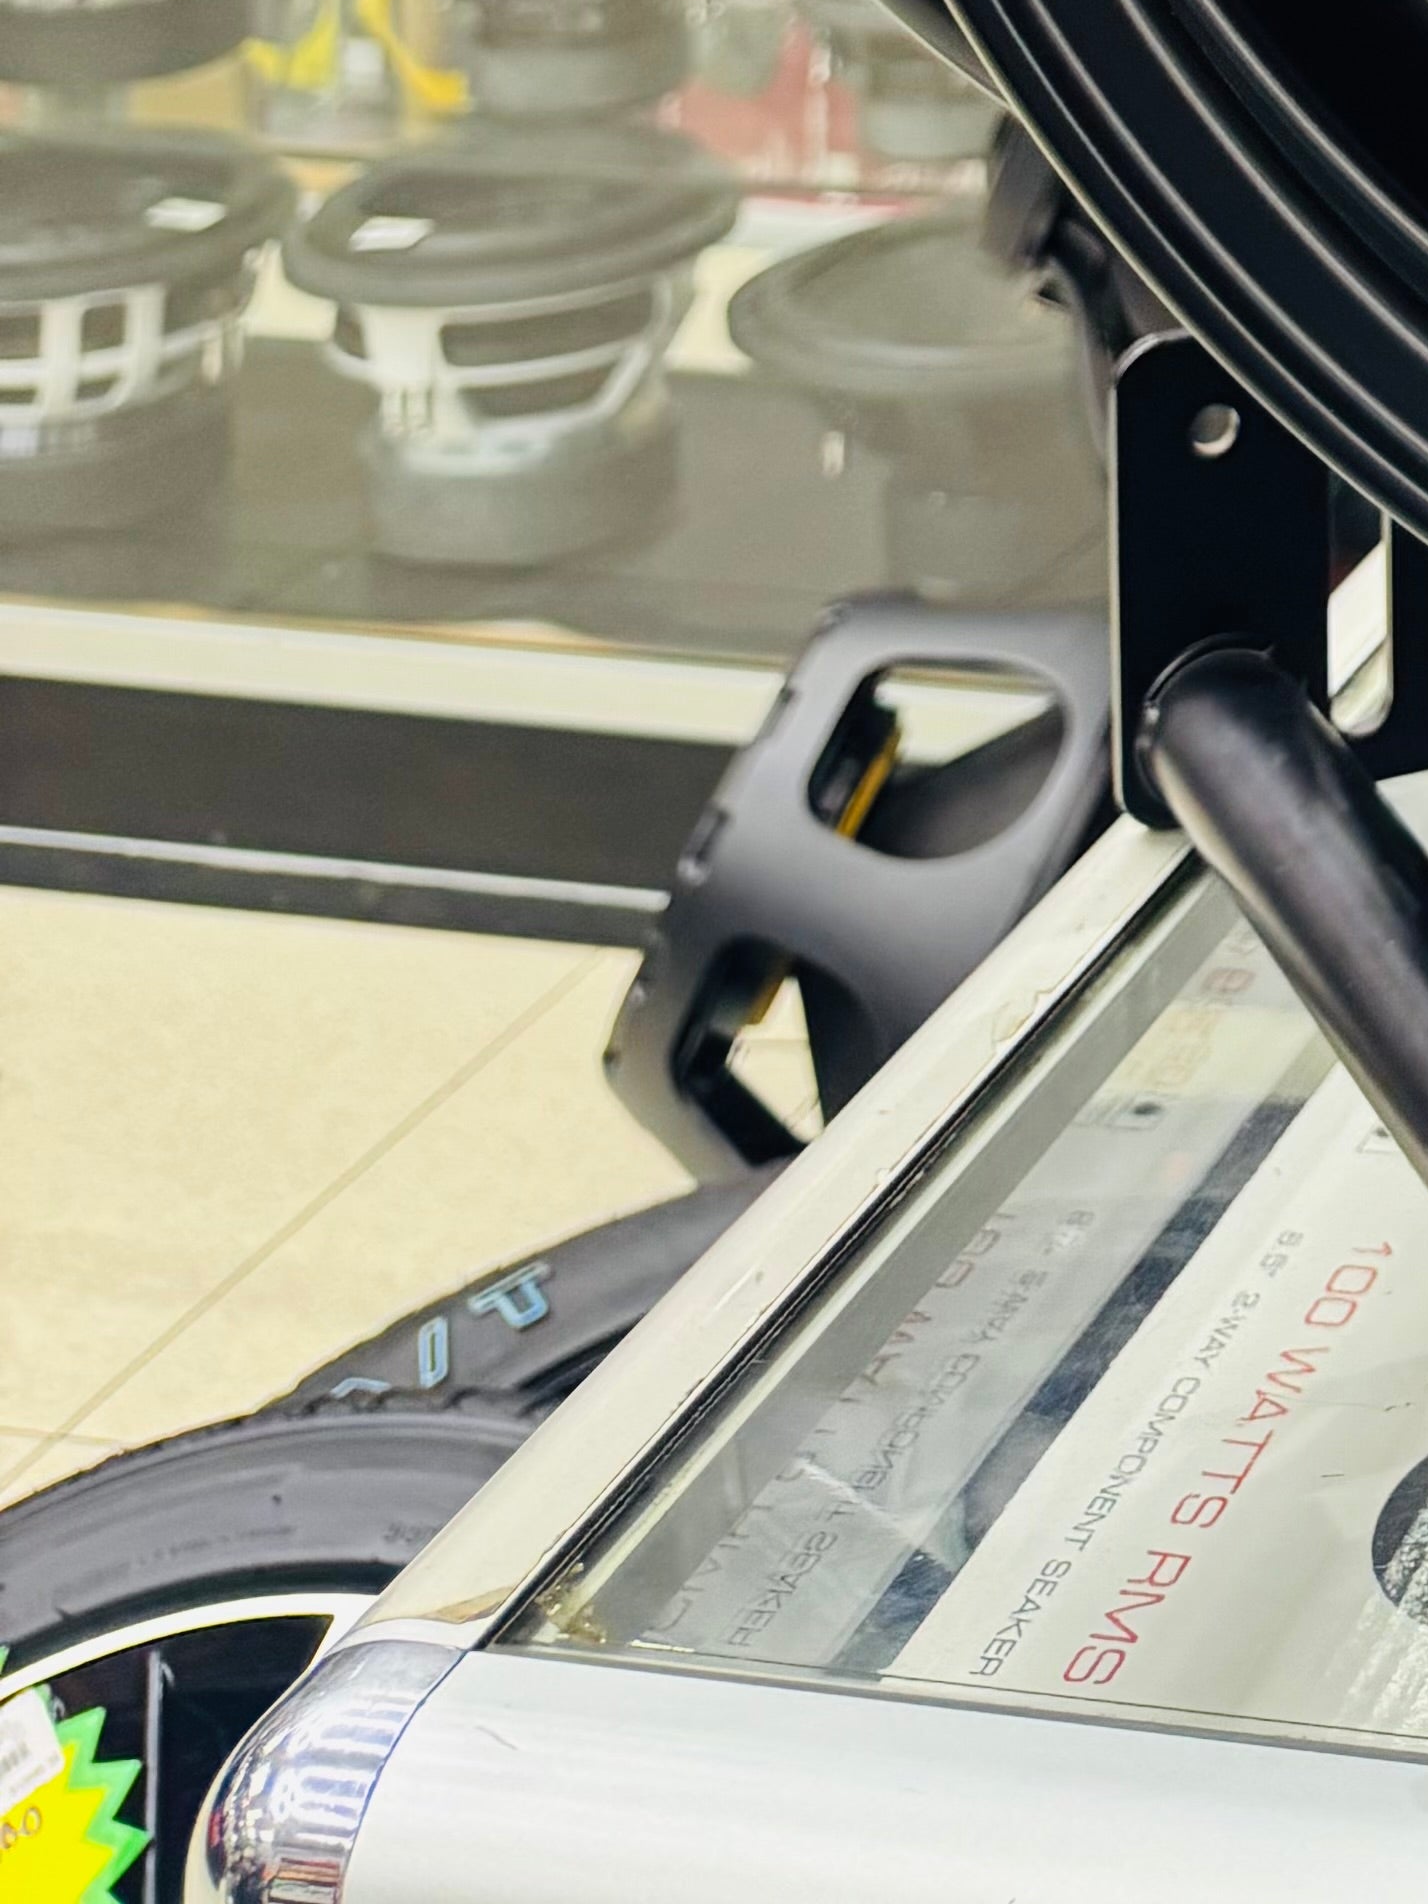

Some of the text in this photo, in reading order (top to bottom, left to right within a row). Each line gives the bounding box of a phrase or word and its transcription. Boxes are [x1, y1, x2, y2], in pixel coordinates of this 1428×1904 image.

[1062, 1241, 1393, 1686] 100 WATTS RMS
[1064, 1376, 1200, 1552] COMPONENT
[969, 1558, 1072, 1678] SEAKER
